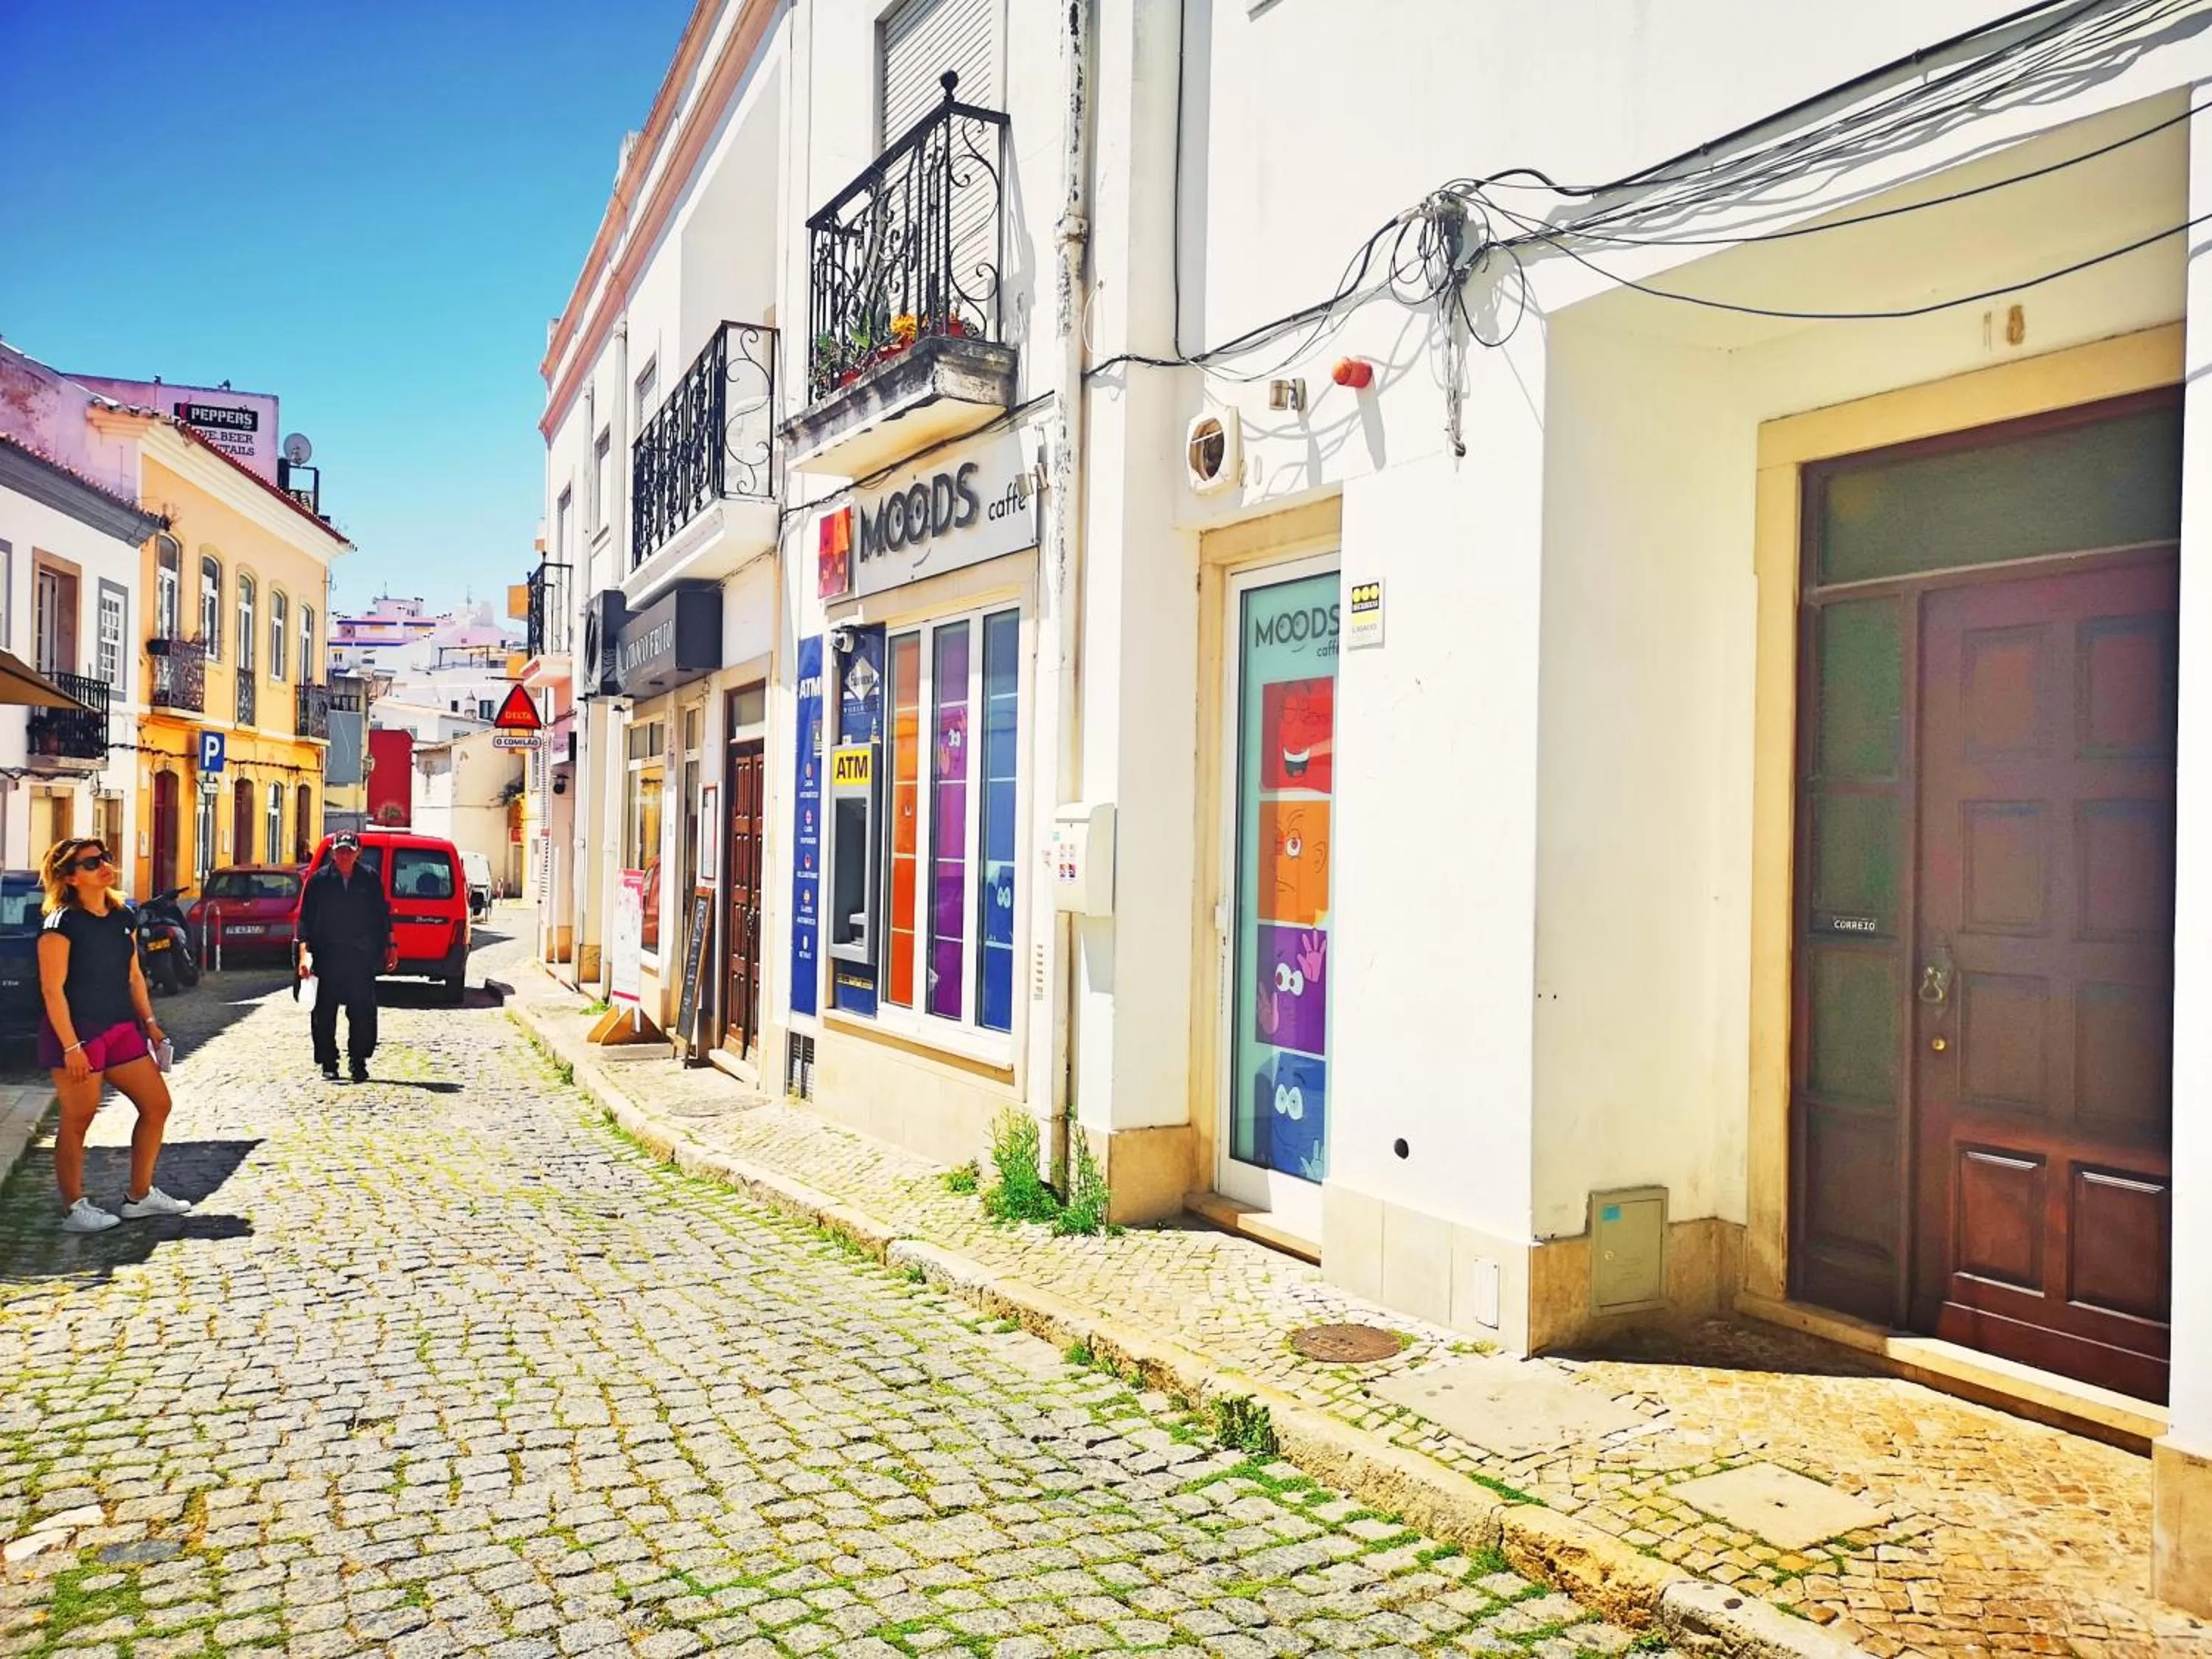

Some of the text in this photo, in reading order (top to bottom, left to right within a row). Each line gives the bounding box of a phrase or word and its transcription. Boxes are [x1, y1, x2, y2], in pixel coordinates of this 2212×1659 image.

[191, 406, 253, 425] PEPPERS
[220, 431, 254, 444] BEER
[860, 462, 981, 563] MOODS
[1255, 603, 1340, 648] MOODS
[1315, 638, 1340, 657] caff
[799, 676, 821, 699] ATM
[204, 735, 220, 768] P
[836, 754, 868, 779] ATM
[1834, 919, 1875, 931] CORREIO
